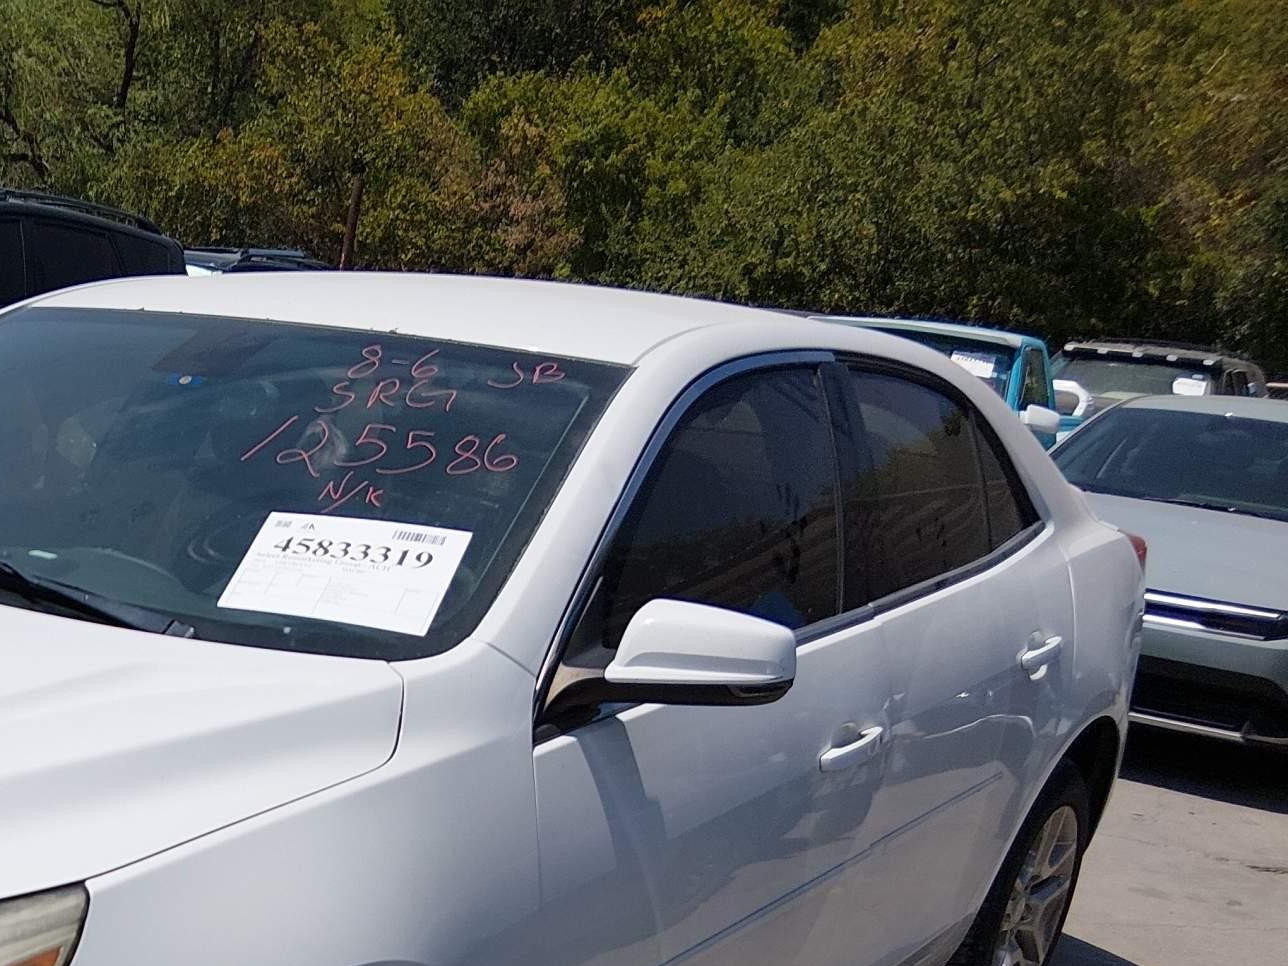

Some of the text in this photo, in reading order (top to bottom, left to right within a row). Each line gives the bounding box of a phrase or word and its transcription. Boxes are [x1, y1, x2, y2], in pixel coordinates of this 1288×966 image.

[347, 344, 440, 379] 8-6
[314, 377, 457, 413] SRG
[240, 415, 518, 478] 125586
[273, 535, 434, 569] 45833319
